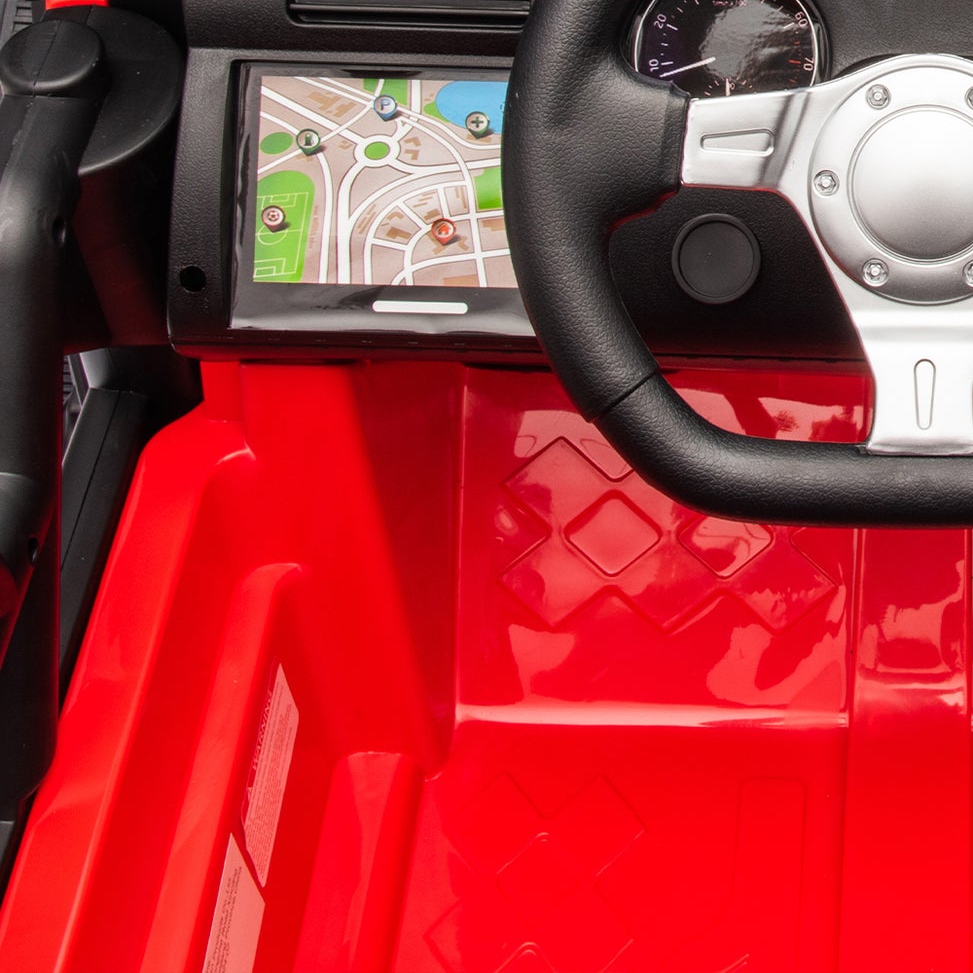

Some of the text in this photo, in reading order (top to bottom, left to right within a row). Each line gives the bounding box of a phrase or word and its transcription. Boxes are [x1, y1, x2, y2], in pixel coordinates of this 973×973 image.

[653, 13, 667, 29] 20
[794, 11, 808, 27] 60
[648, 58, 659, 72] 10
[803, 57, 814, 71] 70
[381, 98, 391, 111] P
